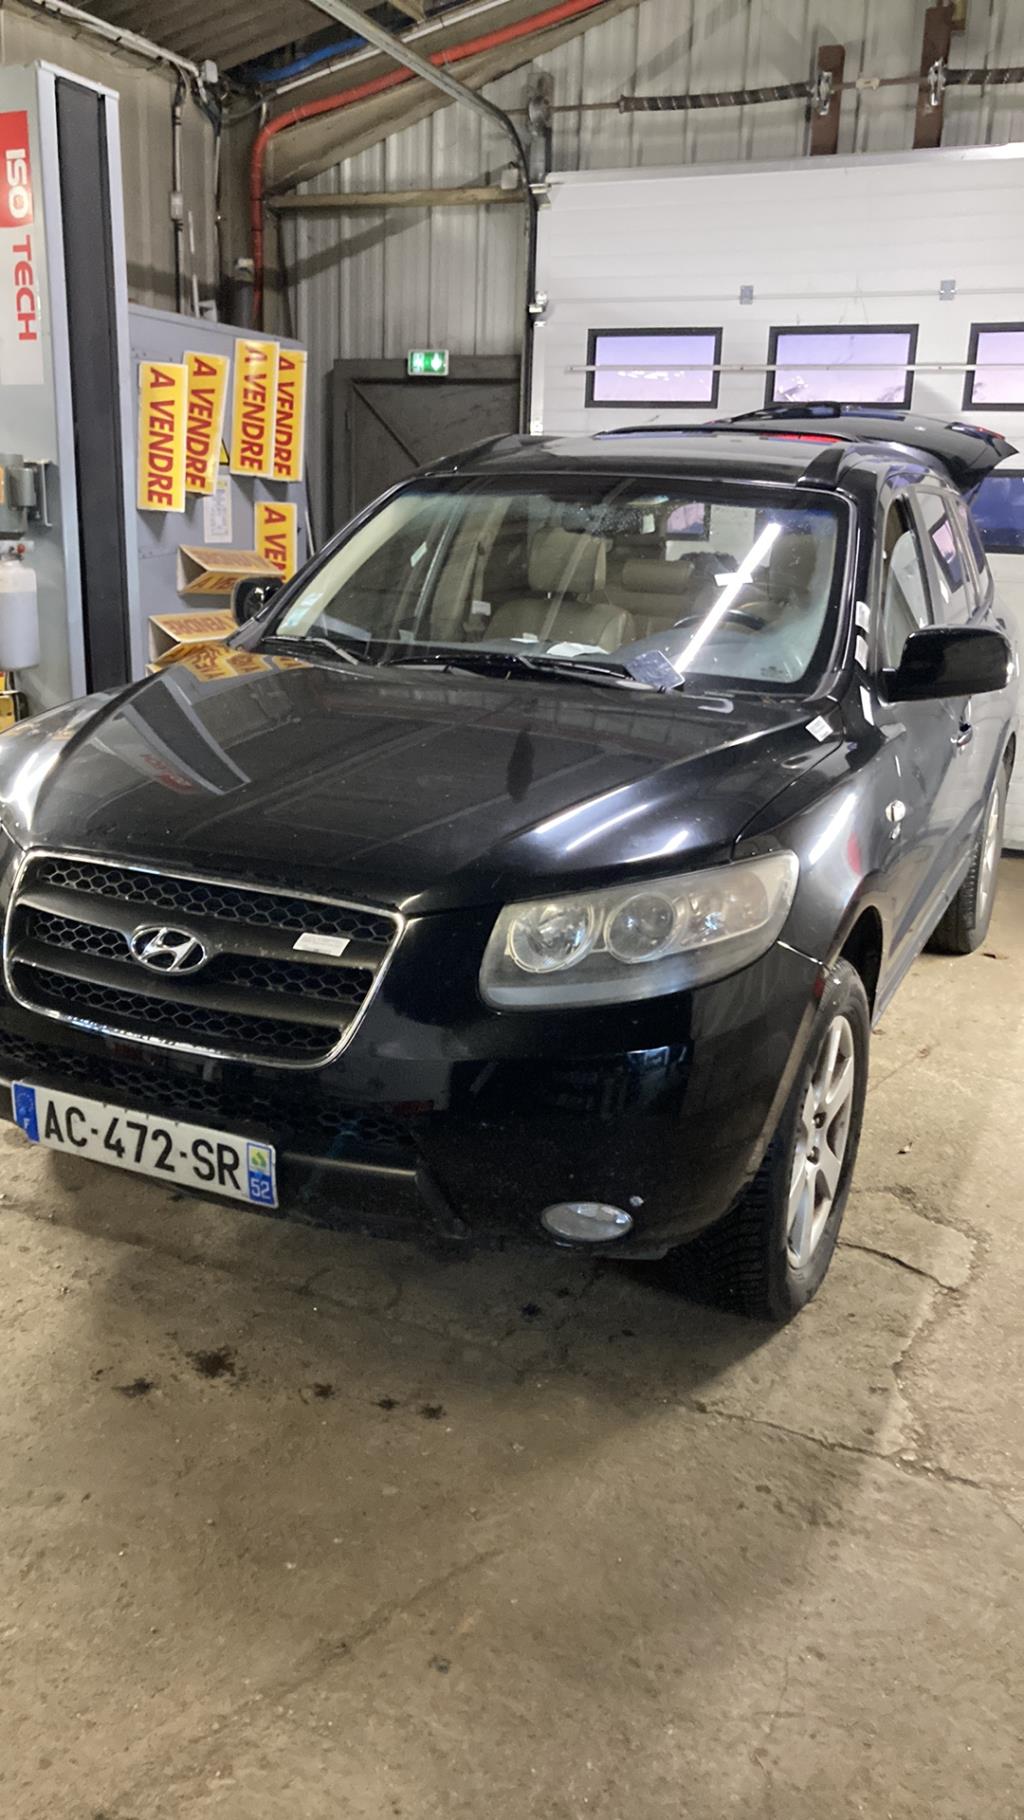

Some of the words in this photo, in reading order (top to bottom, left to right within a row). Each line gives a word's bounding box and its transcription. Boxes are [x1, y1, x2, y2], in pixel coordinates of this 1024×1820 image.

[6, 148, 28, 218] ISO
[12, 234, 37, 341] TECH
[150, 367, 176, 389] A
[193, 357, 217, 377] A
[244, 345, 268, 363] A
[278, 356, 296, 371] A
[147, 399, 175, 506] VENDRE
[185, 389, 215, 488] VENDRE
[239, 373, 267, 471] VENDRE
[274, 381, 295, 477] VENDRE
[264, 505, 287, 525] A
[44, 1100, 241, 1190] AC-472-SR
[250, 1177, 271, 1200] 52
